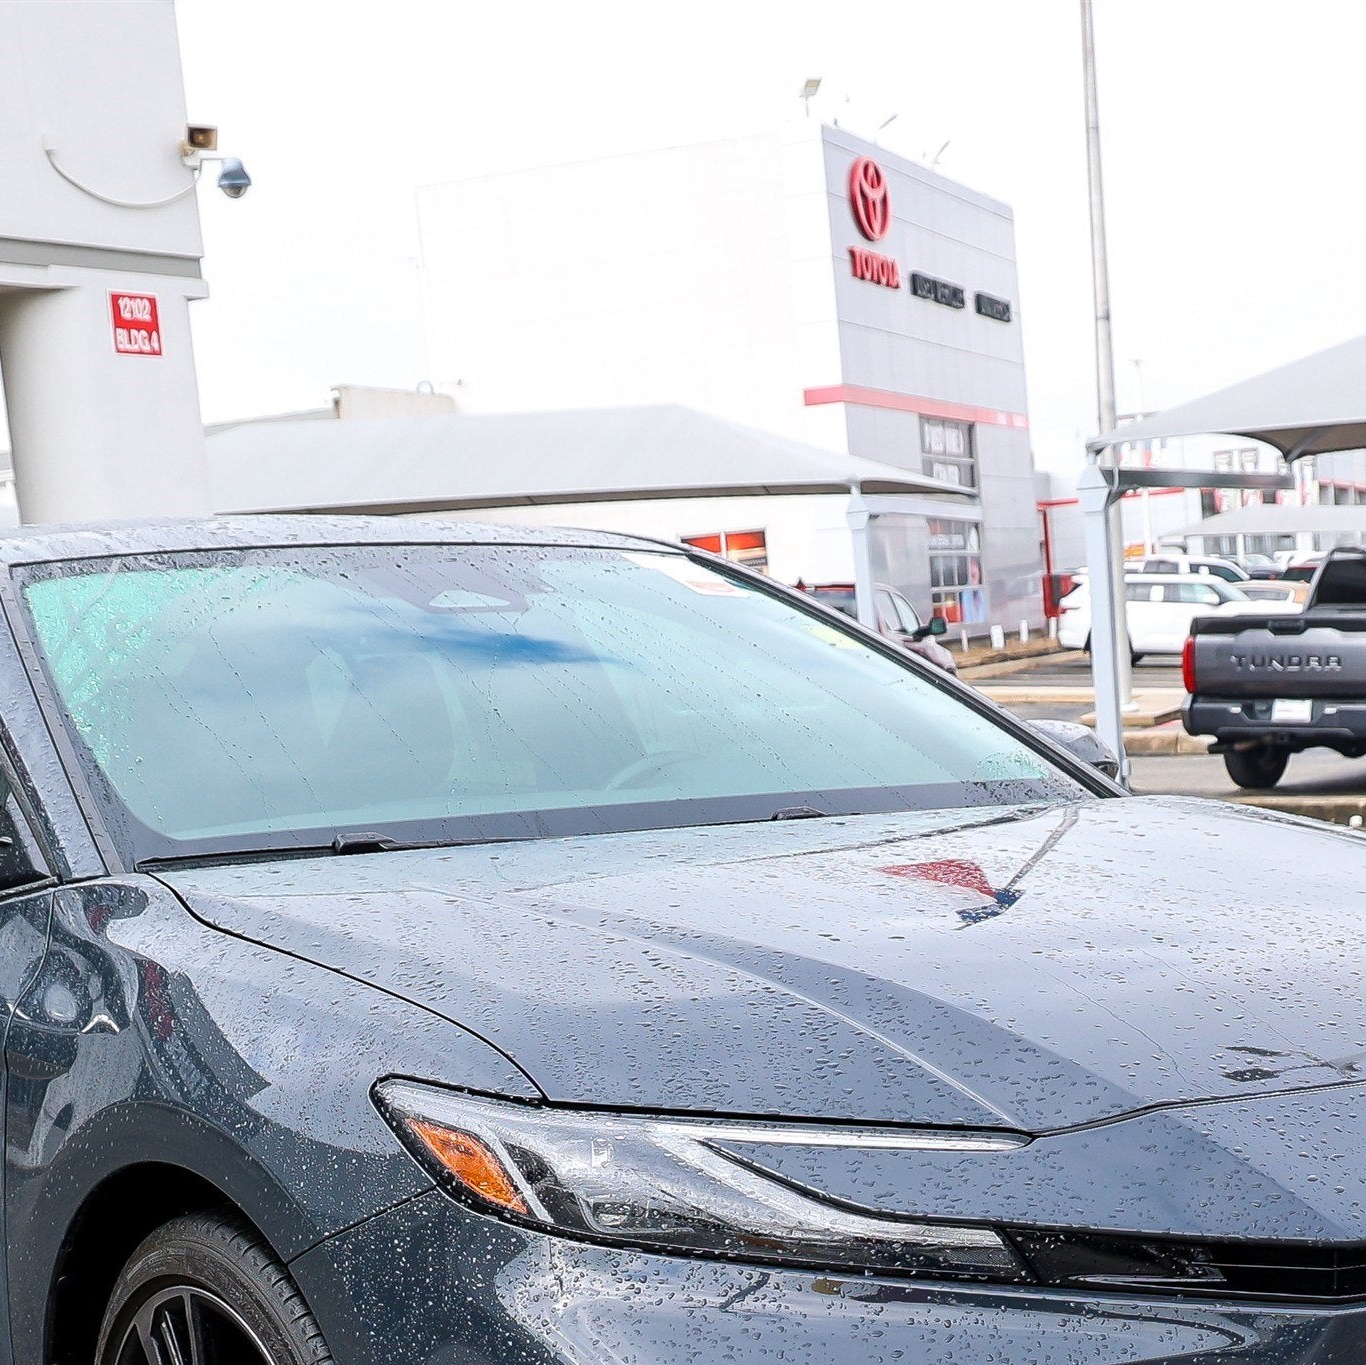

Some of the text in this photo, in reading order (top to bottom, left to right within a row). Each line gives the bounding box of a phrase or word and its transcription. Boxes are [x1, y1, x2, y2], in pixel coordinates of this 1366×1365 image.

[118, 297, 153, 322] 12102
[115, 327, 160, 354] BLDG 4
[1230, 653, 1342, 673] TUNDRA
